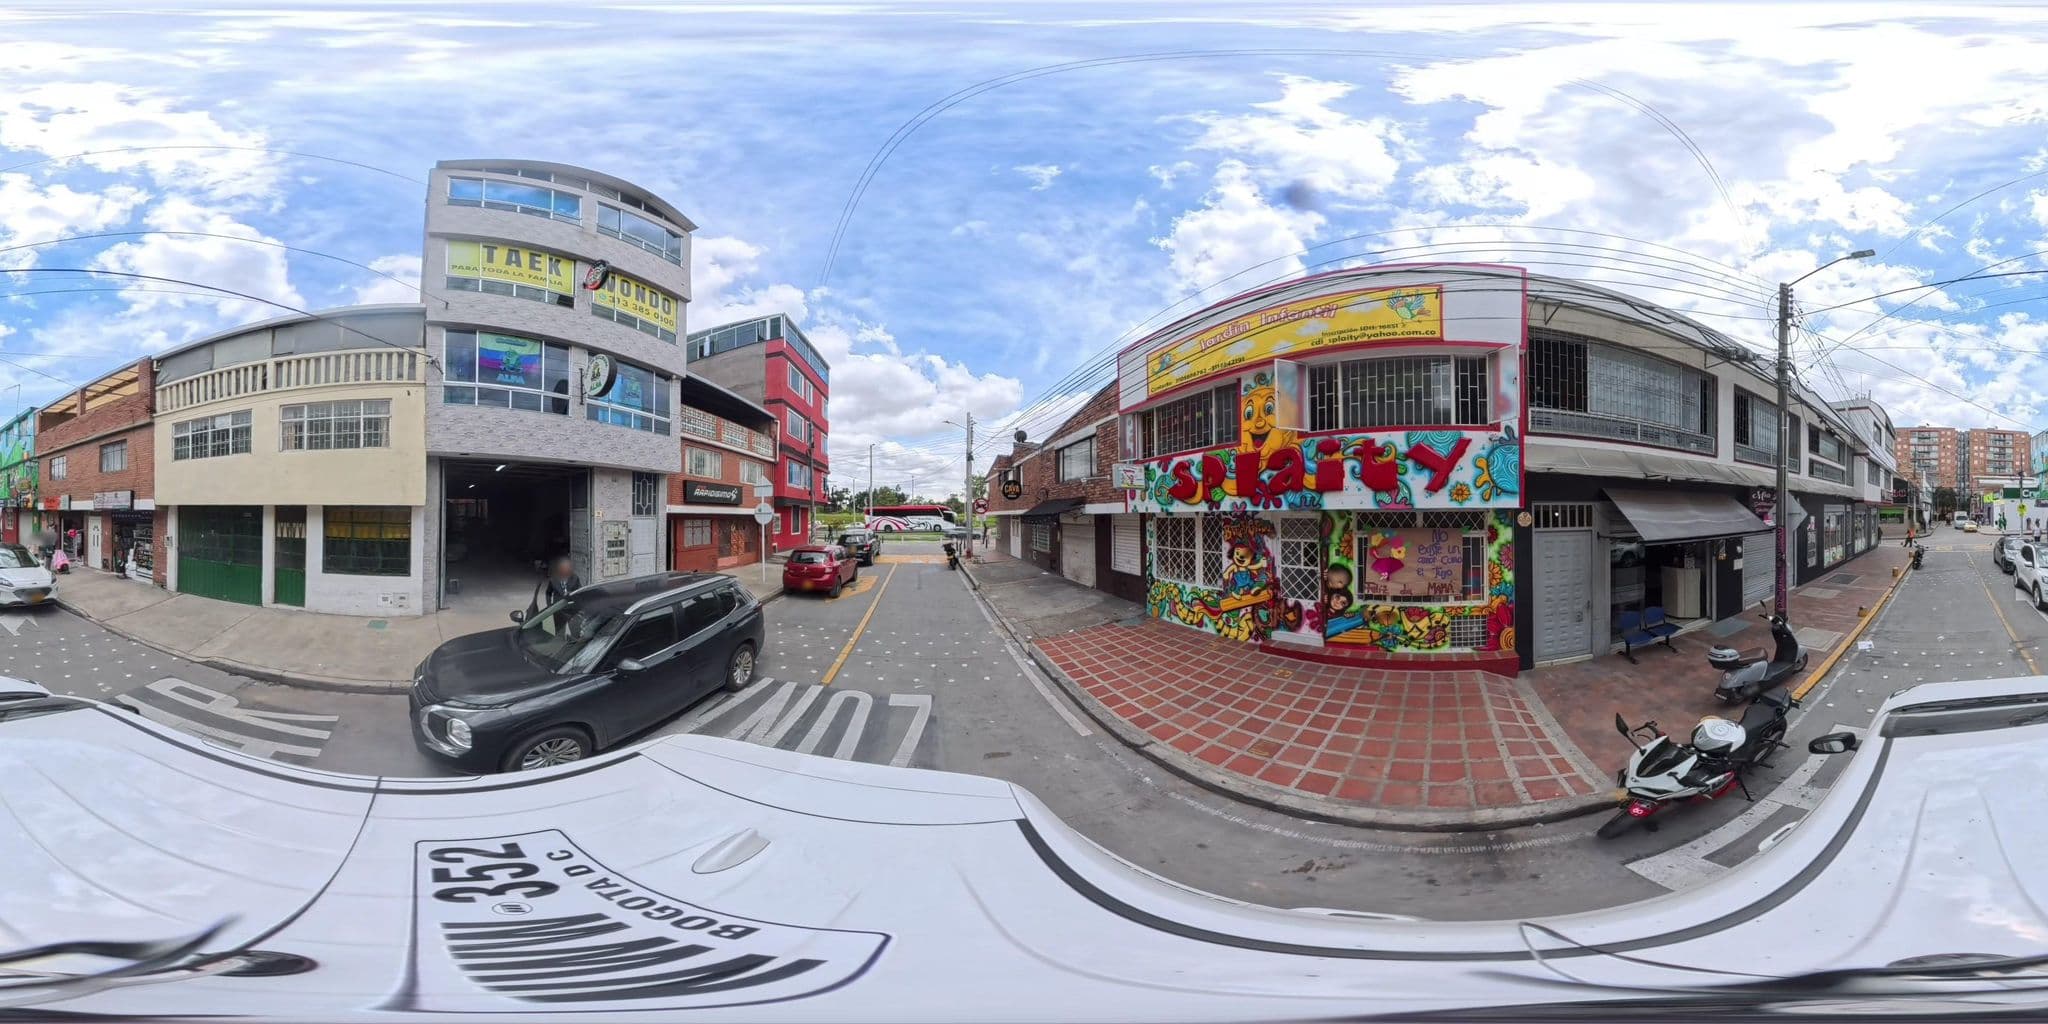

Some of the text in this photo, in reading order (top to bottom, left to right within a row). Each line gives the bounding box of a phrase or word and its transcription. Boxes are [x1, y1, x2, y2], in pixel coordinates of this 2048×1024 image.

[482, 245, 562, 277] TAEK
[428, 842, 560, 903] 352
[594, 877, 760, 941] BOGOTA
